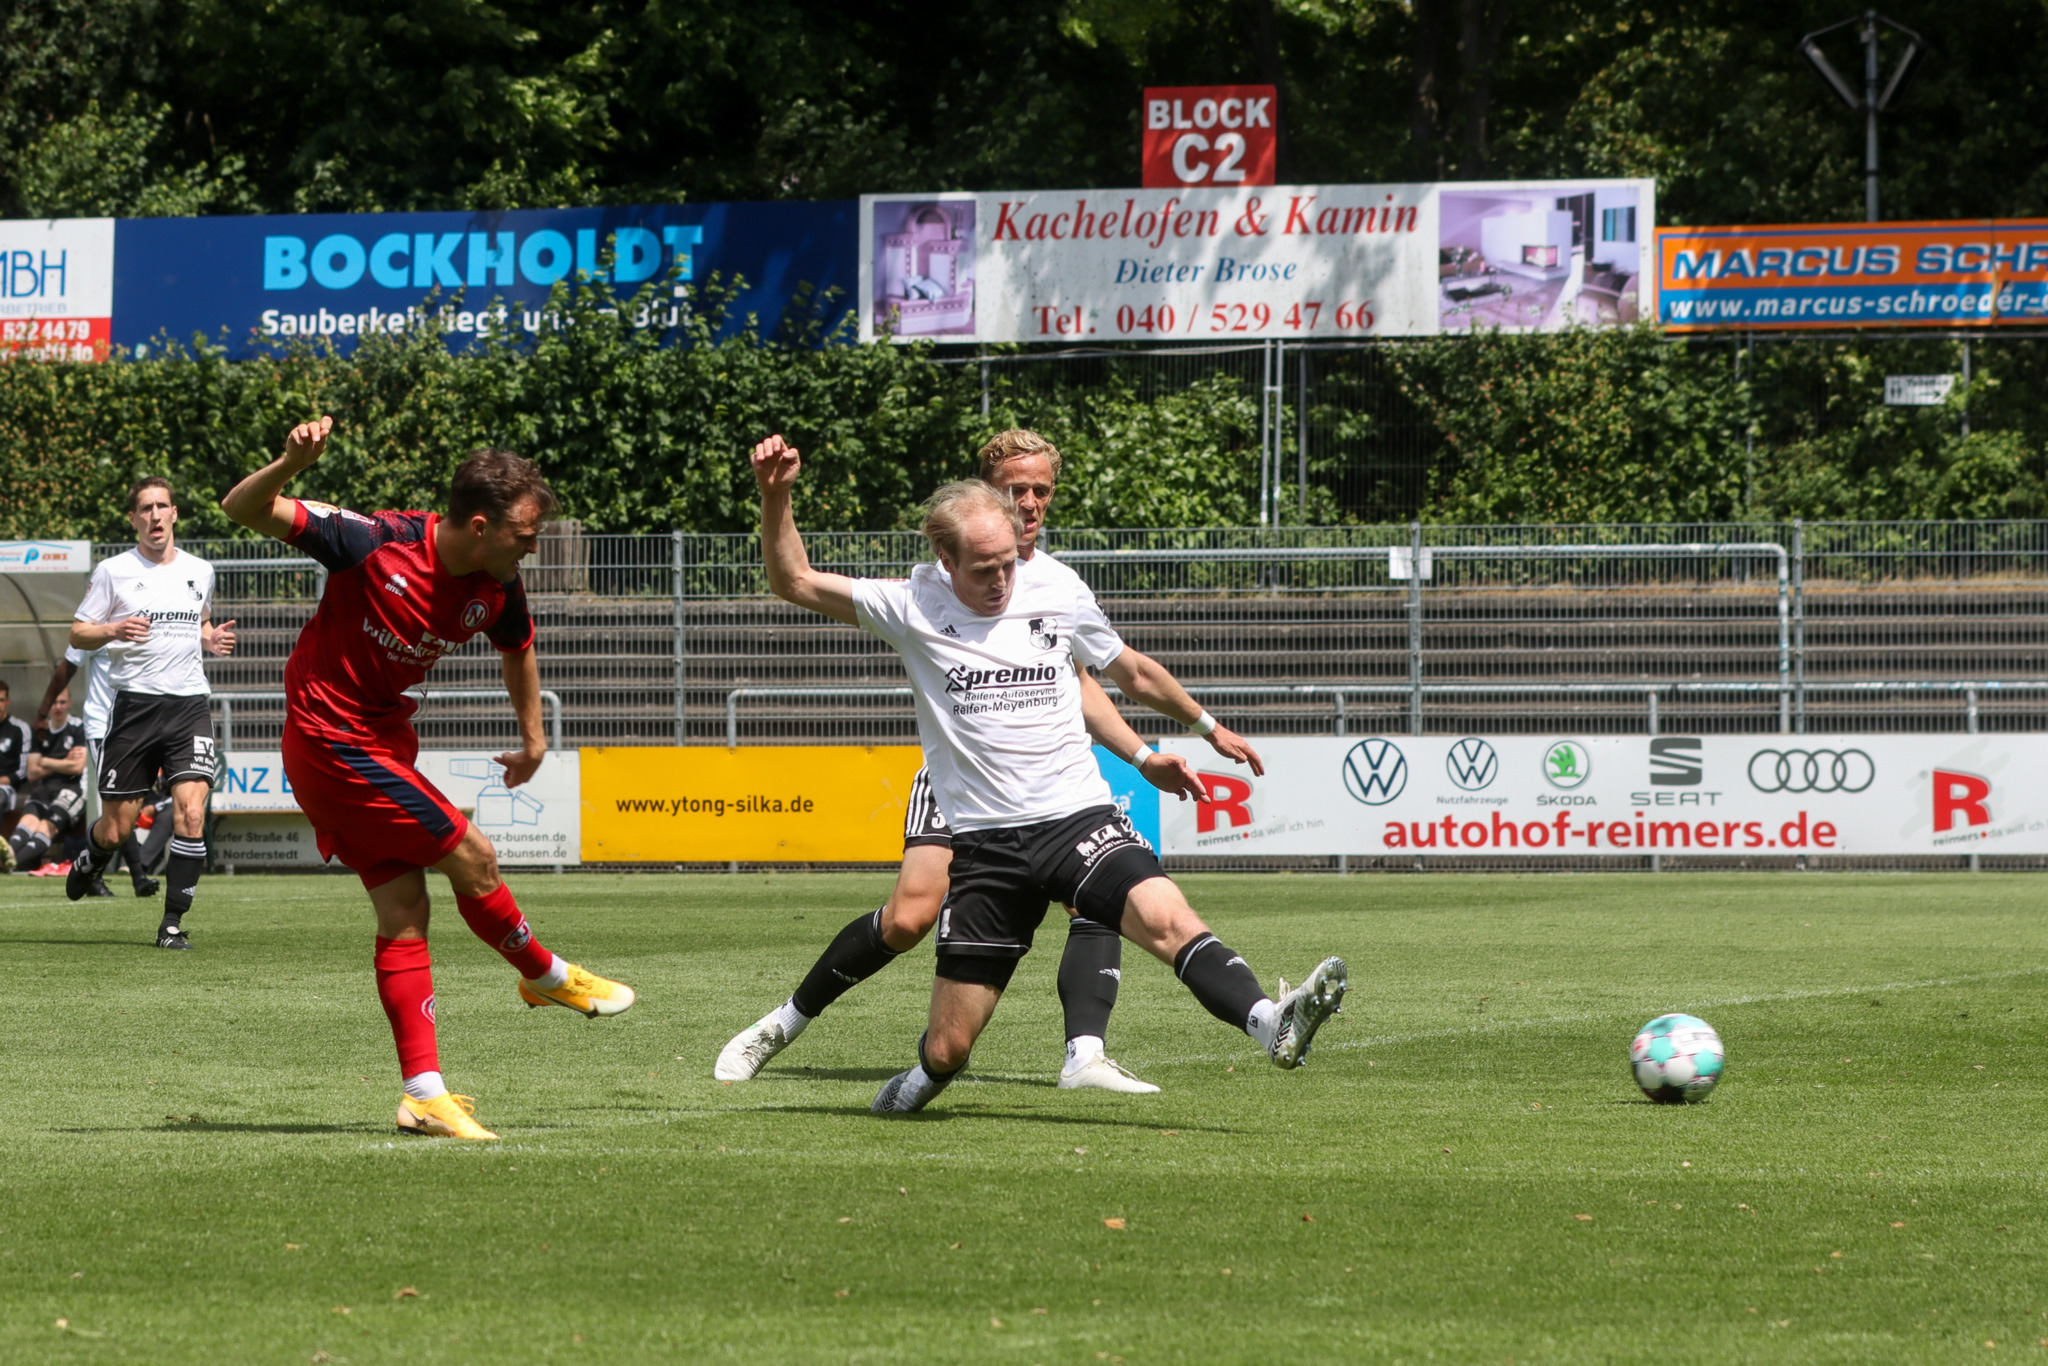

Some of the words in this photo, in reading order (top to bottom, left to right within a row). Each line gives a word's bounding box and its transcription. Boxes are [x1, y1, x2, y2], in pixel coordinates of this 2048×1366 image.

[1148, 97, 1271, 130] BLOCK
[1171, 132, 1247, 184] C2
[992, 198, 1220, 249] Kachelofen
[1234, 196, 1269, 238] &
[1281, 193, 1419, 236] Kamin
[263, 224, 703, 290] BOCKHOLDT
[1671, 244, 1902, 280] MARCUS
[1114, 257, 1206, 285] Dieter
[1213, 257, 1298, 284] Brose
[1669, 288, 2048, 320] www.marcus-schroeder-
[1032, 305, 1097, 336] Tel.
[1116, 303, 1176, 334] 040
[1186, 303, 1199, 334] /
[1209, 302, 1271, 333] 529
[1283, 302, 1322, 332] 47
[1334, 301, 1375, 331] 66
[149, 610, 199, 624] premio
[966, 663, 1057, 691] premio
[953, 696, 1058, 716] Reifen-Meyenburg
[106, 768, 118, 788] 2
[616, 795, 814, 817] www.ytong-silka.de
[1436, 795, 1509, 805] Nutzfahrzeuge
[1630, 792, 1723, 806] SEAT
[245, 831, 283, 843] Straße
[286, 832, 300, 842] 46
[484, 832, 567, 842] inz-bunsen.de
[1197, 832, 1242, 847] reimers
[1382, 811, 1838, 848] autohof-reimers.de
[1933, 832, 1980, 847] reimers
[223, 849, 299, 860] Norderstedt
[496, 846, 568, 858] z-bunsen.de
